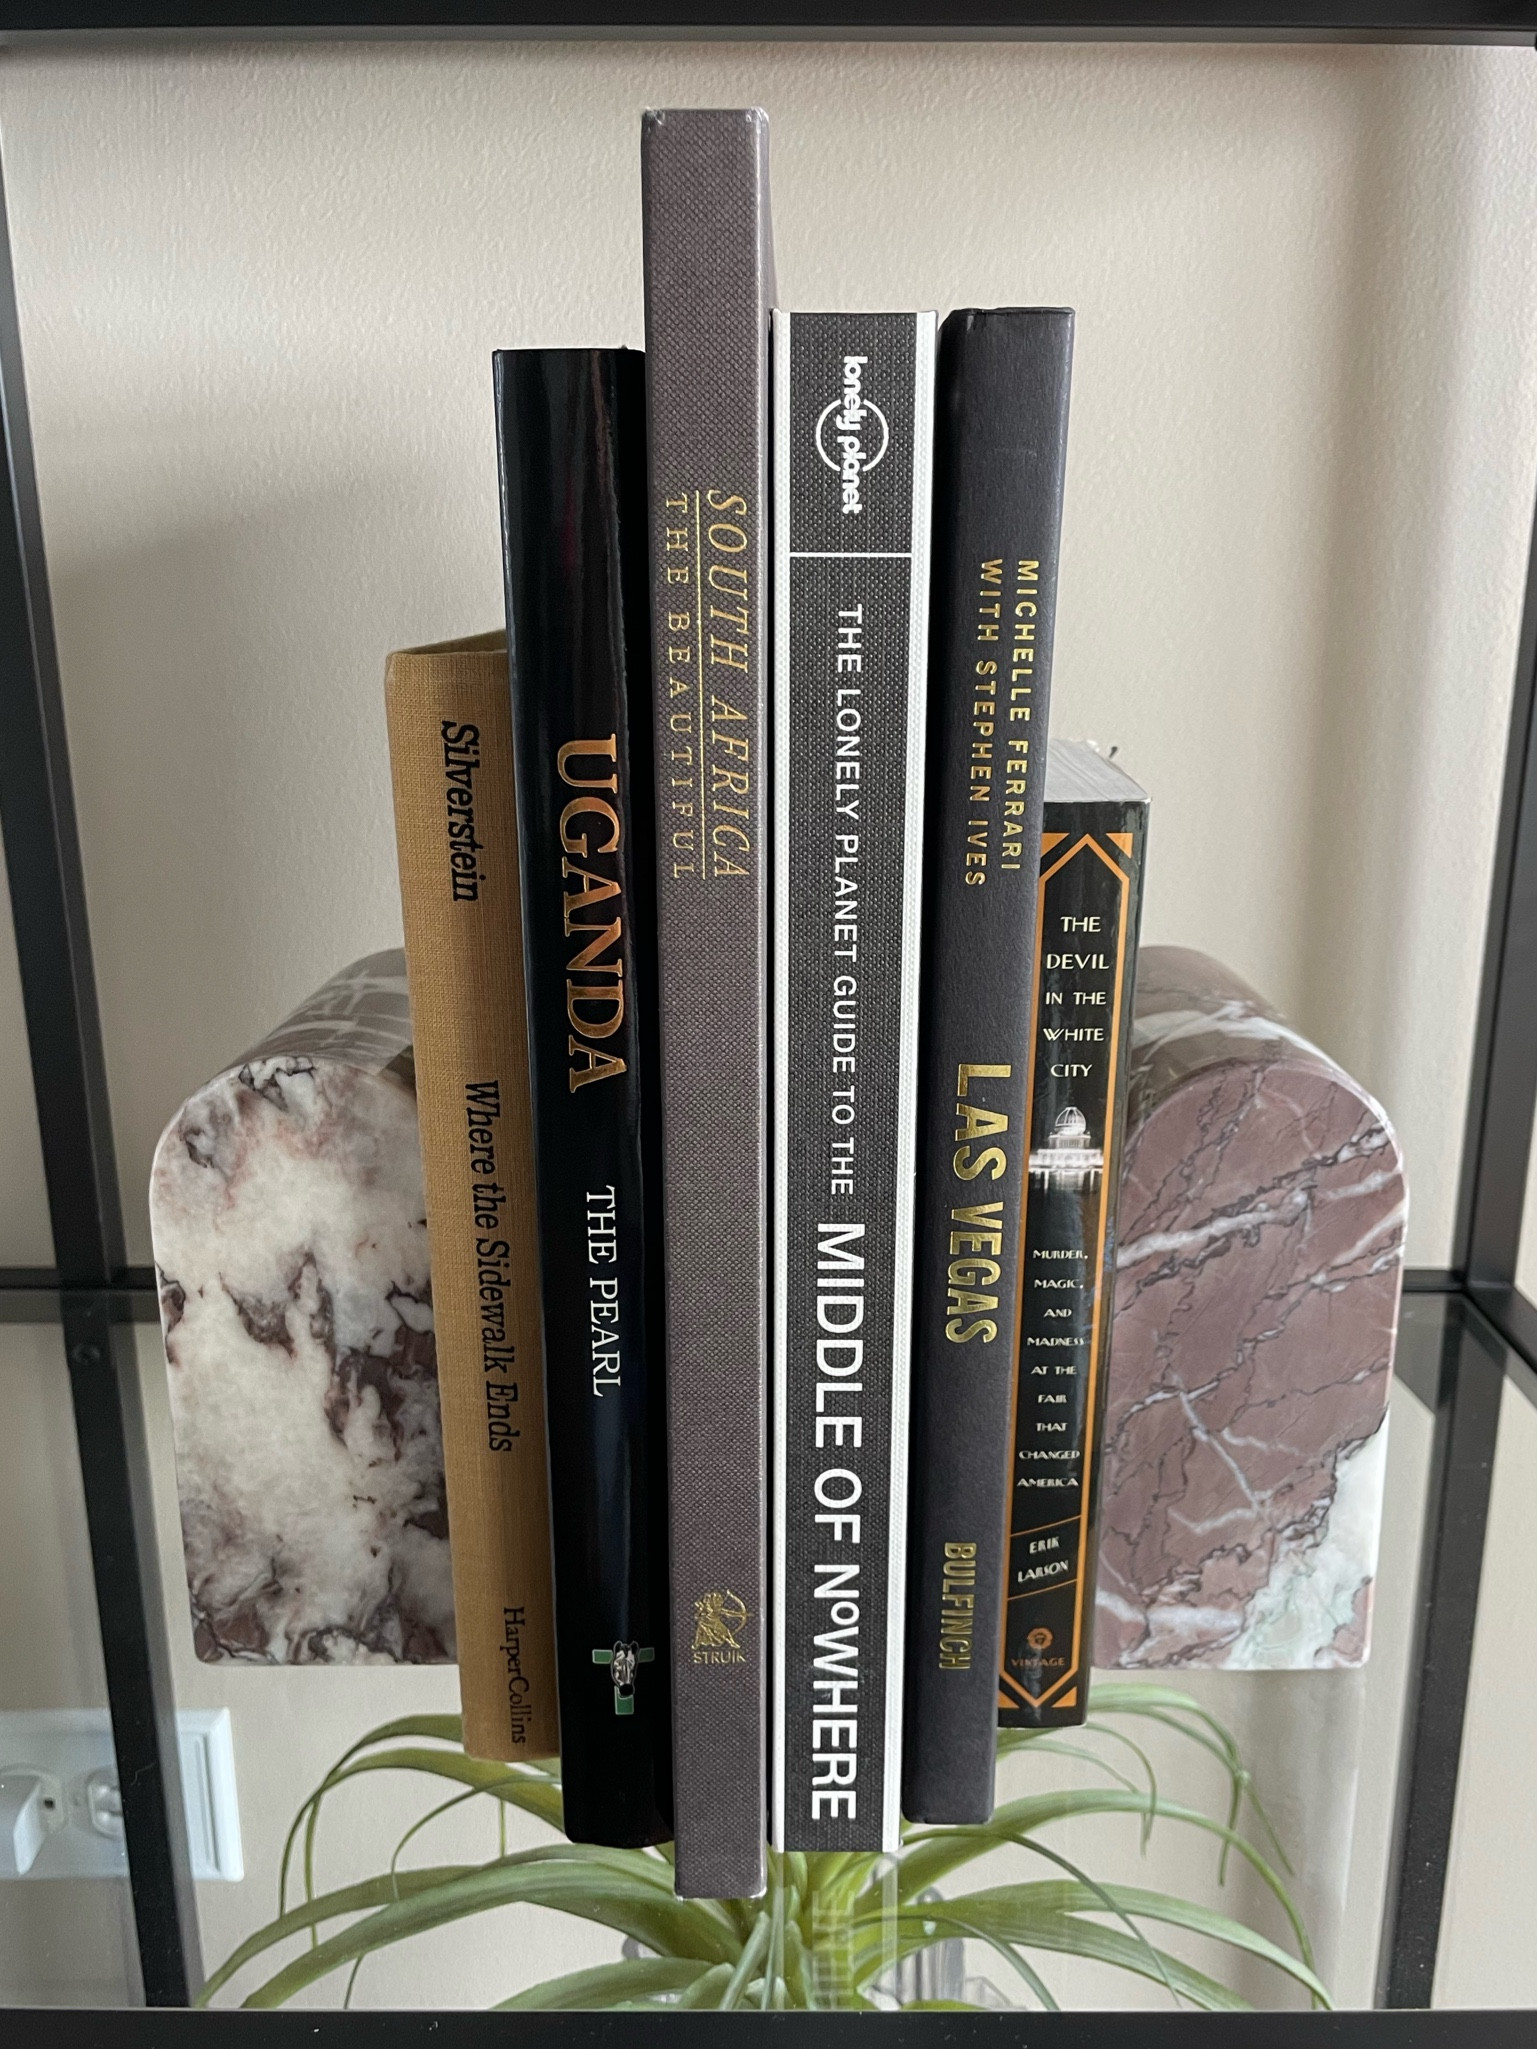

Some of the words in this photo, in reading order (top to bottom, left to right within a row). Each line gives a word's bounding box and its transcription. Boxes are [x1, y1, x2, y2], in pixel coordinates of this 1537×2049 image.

[836, 356, 868, 430] lonely
[837, 436, 866, 514] planet
[665, 492, 689, 585] THE
[707, 489, 748, 674] SOUTH
[977, 558, 1003, 642] WITH
[837, 604, 863, 674] THE
[1010, 560, 1040, 722] MICHELLE
[668, 610, 694, 879] BEAUTIFUL
[834, 688, 862, 822] LONELY
[969, 659, 998, 802] STEPHEN
[441, 720, 484, 902] Silverstein
[710, 694, 751, 878] AFRICA
[1001, 740, 1029, 870] FERRARI
[965, 819, 988, 885] IVES
[557, 733, 627, 1093] UGANDA
[833, 834, 860, 963] PLANET
[1060, 915, 1102, 933] THE
[1045, 991, 1063, 1005] IN
[1073, 991, 1107, 1005] THE
[1046, 953, 1110, 970] DEVIL
[832, 974, 858, 1074] GUIDE
[1043, 1027, 1105, 1042] WHITE
[831, 1084, 856, 1126] TO
[1050, 1063, 1093, 1078] CITY
[465, 1080, 501, 1175] Where
[953, 1063, 1011, 1181] LAS
[831, 1136, 854, 1196] THE
[472, 1182, 506, 1230] the
[586, 1184, 617, 1264] THE
[475, 1236, 515, 1374] Sidewalk
[945, 1201, 1003, 1343] VEGAS
[589, 1275, 620, 1399] PEARL
[814, 1222, 866, 1449] MIDDLE
[1027, 1336, 1085, 1347] MADNESS
[1043, 1308, 1072, 1318] AND
[1030, 1366, 1049, 1376] AT
[1054, 1366, 1077, 1376] THE
[1037, 1394, 1067, 1404] FAIR
[485, 1382, 521, 1452] Ends
[1018, 1450, 1081, 1460] CHANGED
[1035, 1422, 1068, 1432] THAT
[813, 1468, 863, 1544] OF
[1016, 1478, 1079, 1488] AMERICA
[1017, 1560, 1070, 1584] LARSON
[1028, 1536, 1060, 1555] ERIK
[939, 1541, 976, 1670] BULFINCH
[500, 1606, 532, 1744] HarperCollins
[693, 1650, 747, 1665] STRUIK
[1010, 1656, 1066, 1668] VINTAGE
